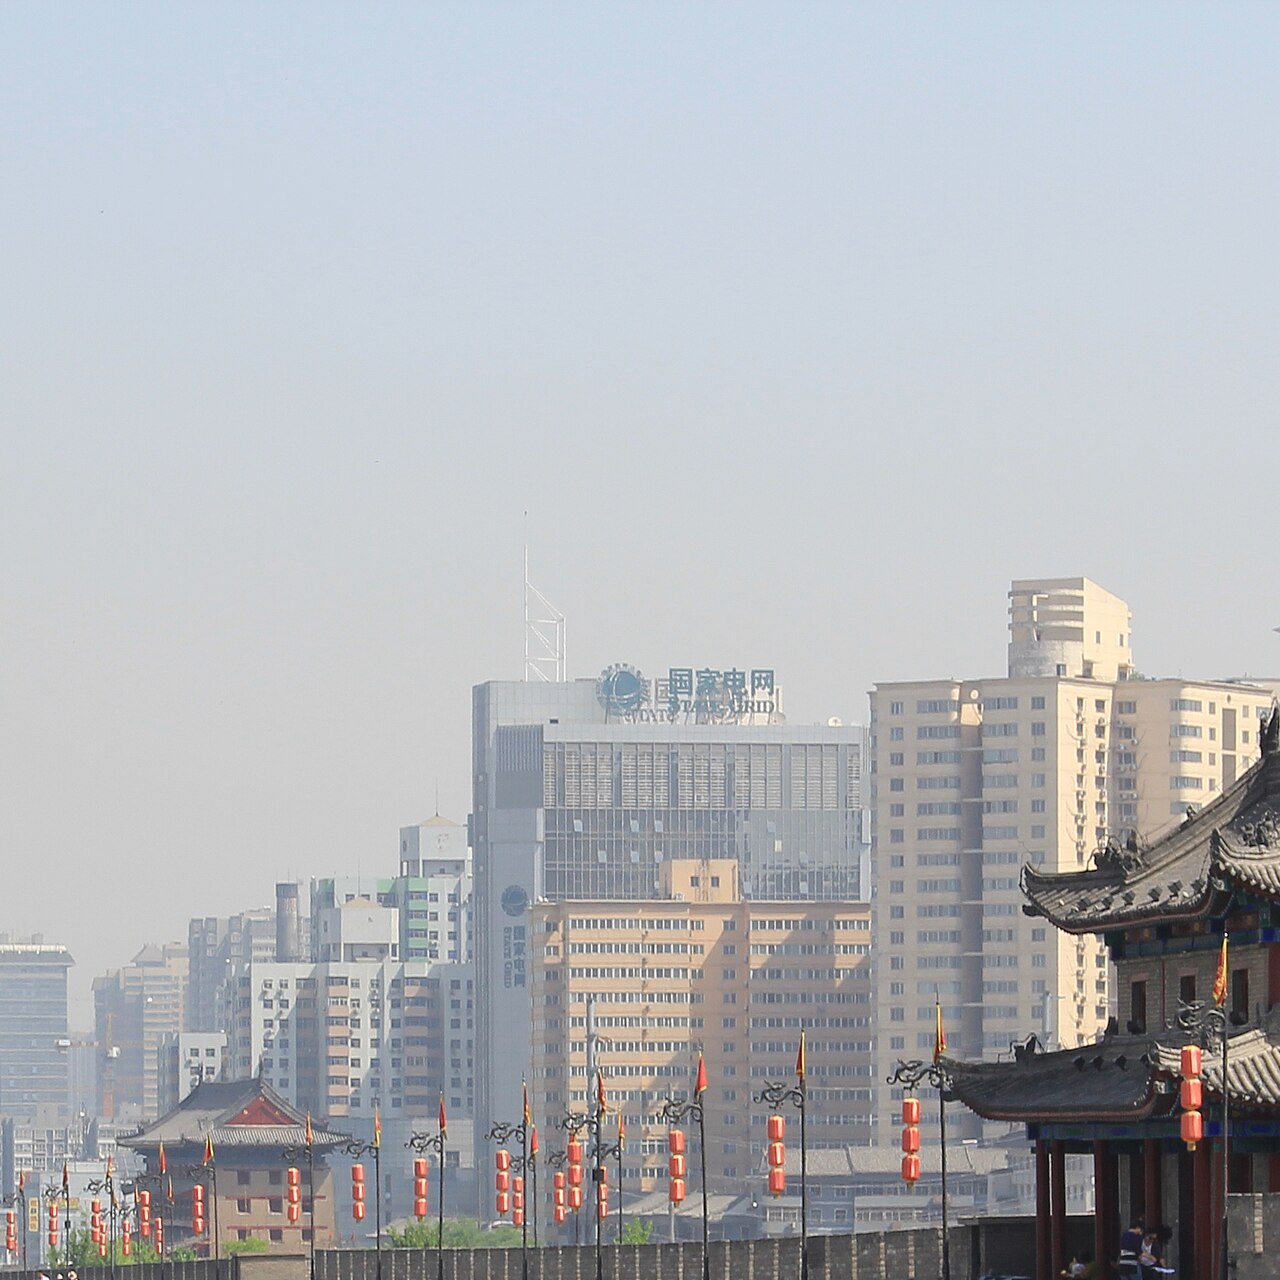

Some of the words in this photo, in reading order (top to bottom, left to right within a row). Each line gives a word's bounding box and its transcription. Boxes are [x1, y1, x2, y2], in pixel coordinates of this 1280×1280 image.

[669, 667, 775, 697] 国家电网
[729, 699, 775, 714] GRID
[503, 926, 512, 959] STATE
[513, 925, 526, 988] 国家电网
[504, 961, 513, 989] GRID
